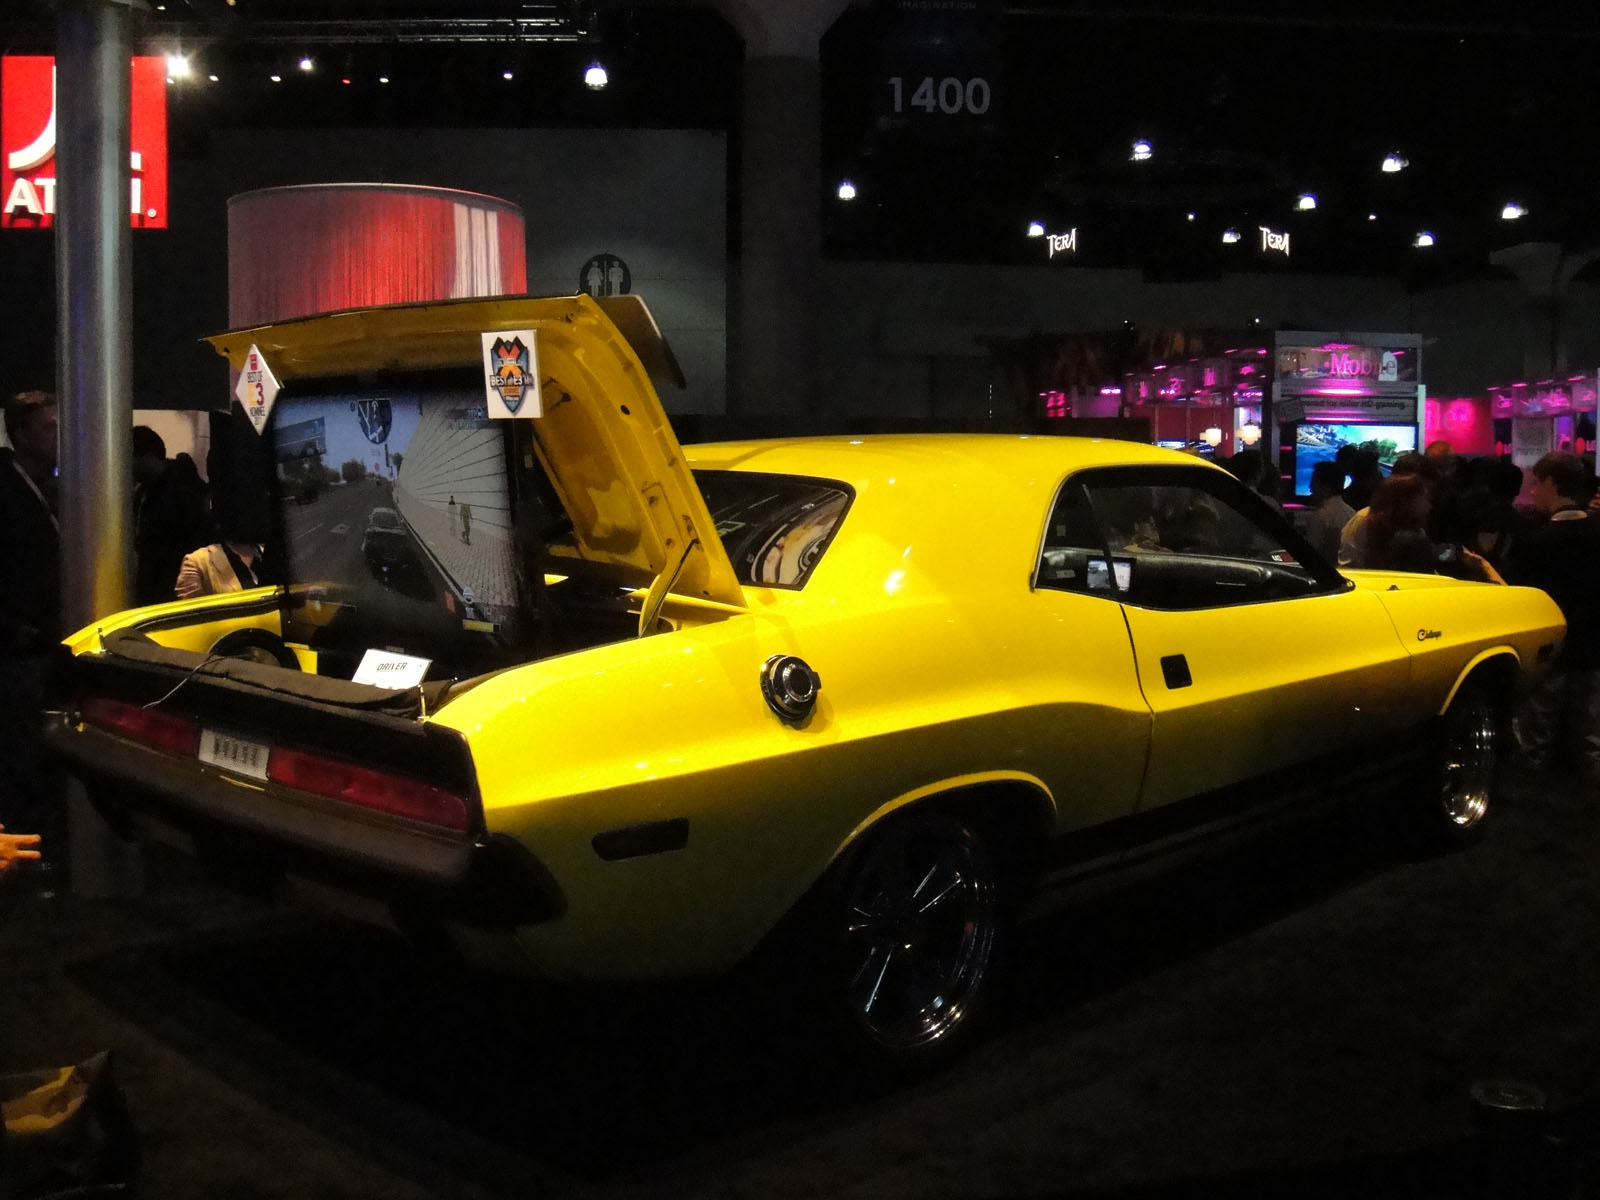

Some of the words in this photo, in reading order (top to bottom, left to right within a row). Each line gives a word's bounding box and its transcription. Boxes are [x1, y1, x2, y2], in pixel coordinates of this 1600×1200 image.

[888, 76, 991, 114] 1400
[4, 178, 141, 214] ATI
[1046, 227, 1077, 259] TERA
[1259, 225, 1290, 257] TERA
[490, 375, 507, 387] BEST
[376, 662, 408, 670] DRIVER
